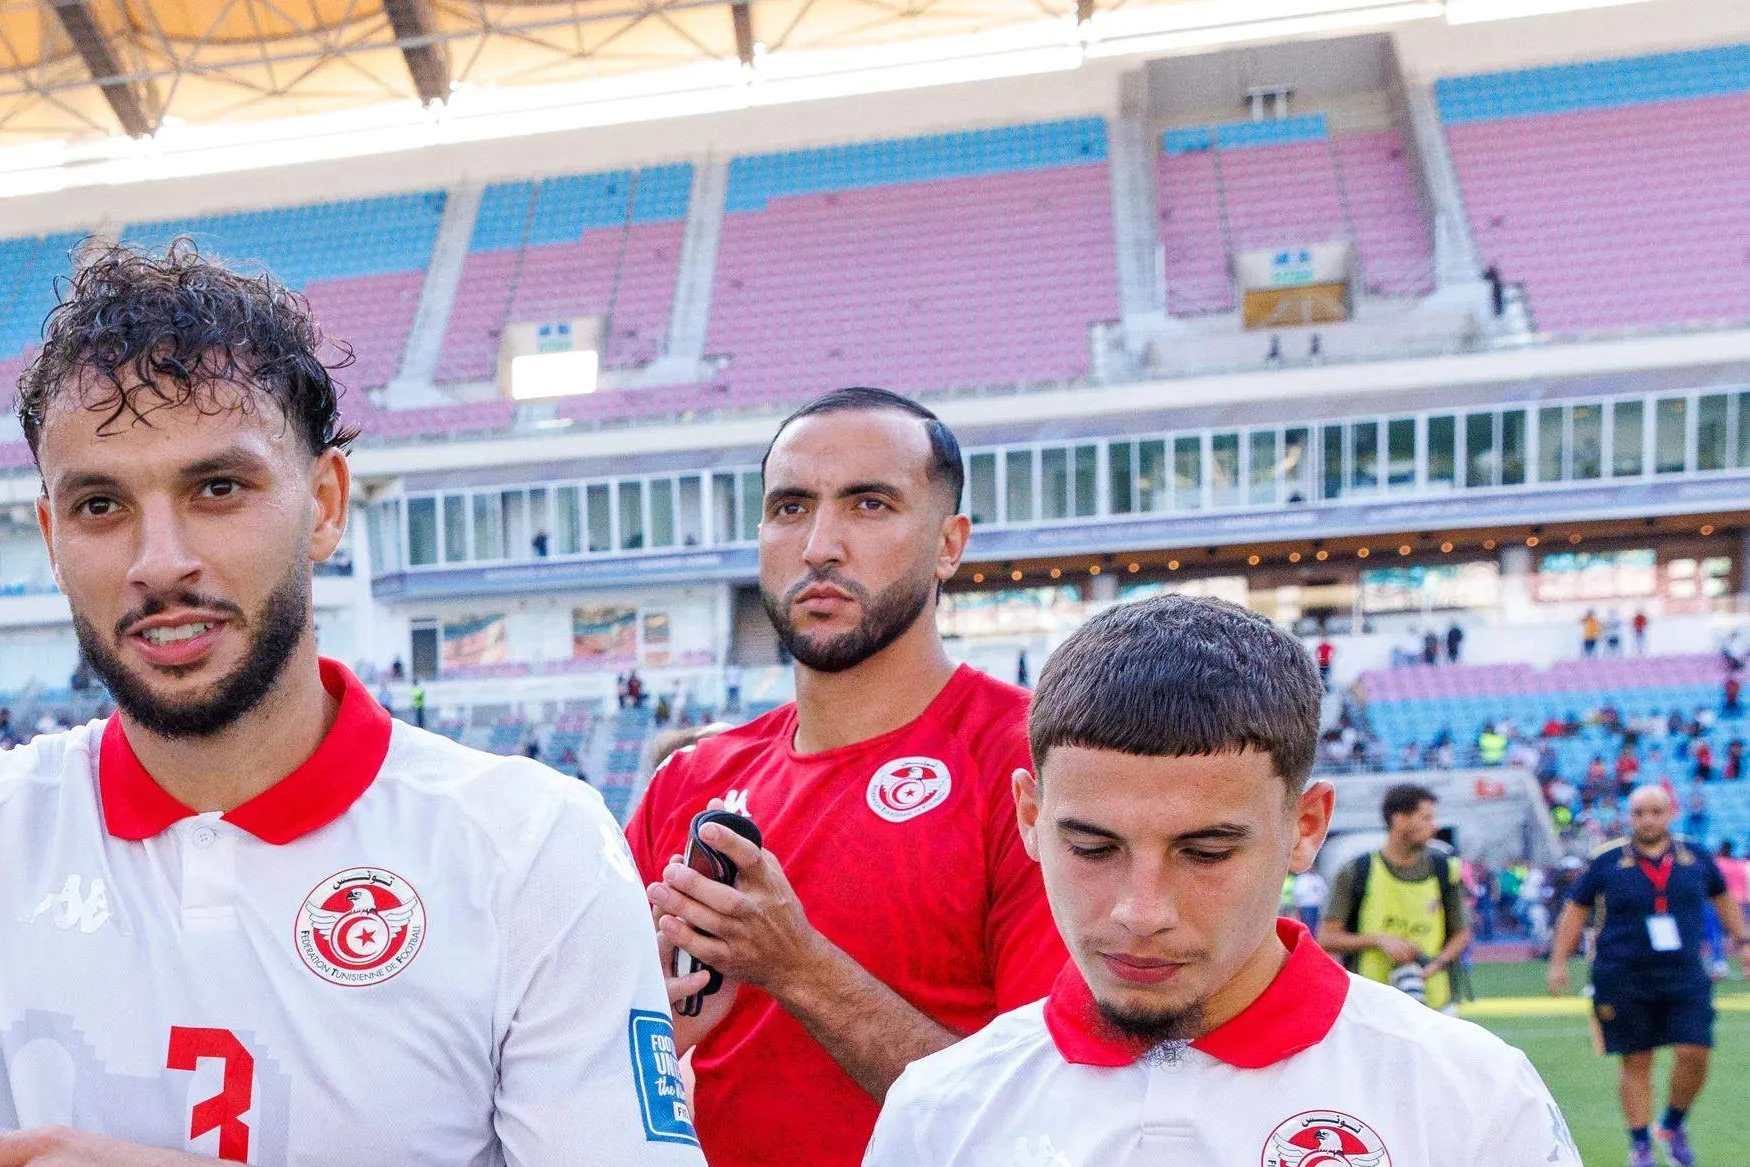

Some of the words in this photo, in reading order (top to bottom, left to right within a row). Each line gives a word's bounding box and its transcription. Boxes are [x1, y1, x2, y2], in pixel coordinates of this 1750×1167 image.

[331, 968, 384, 982] TUNISIENNE
[385, 963, 398, 973] DE
[167, 1026, 254, 1164] 3
